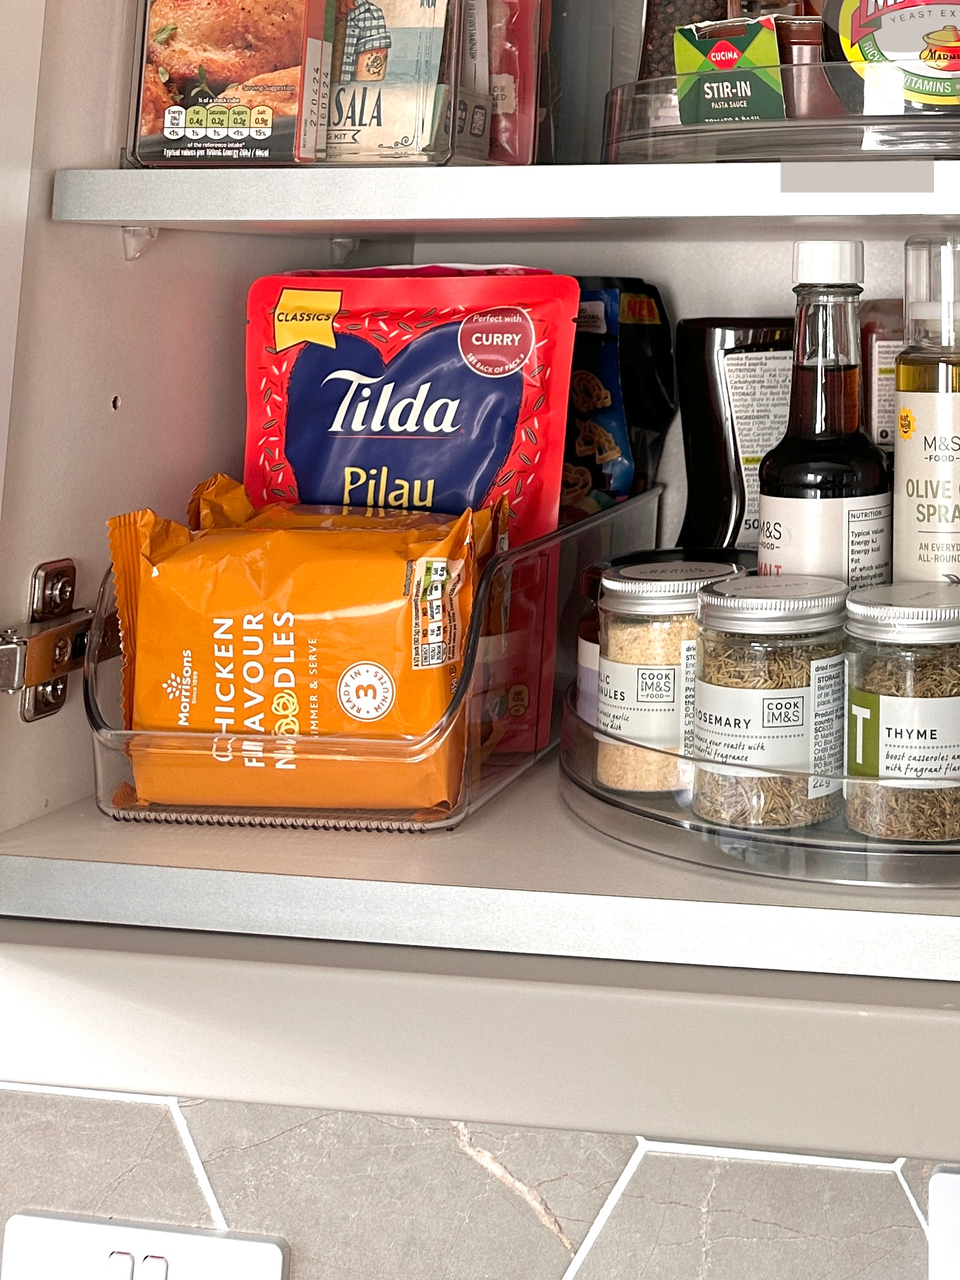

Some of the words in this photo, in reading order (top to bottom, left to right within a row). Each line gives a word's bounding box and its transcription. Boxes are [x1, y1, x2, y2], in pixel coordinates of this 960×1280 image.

[889, 9, 933, 25] YEAST
[710, 51, 739, 61] CUCINA
[309, 66, 320, 127] 270424
[704, 81, 752, 100] STIR-IN
[711, 101, 729, 109] PASTA
[730, 100, 747, 108] SAUCE
[189, 117, 204, 127] 0.4g
[211, 117, 225, 127] 0.2g
[233, 117, 247, 127] 0.2g
[254, 117, 269, 127] 0.9g
[277, 312, 332, 323] CLASSICS
[473, 314, 502, 323] Perfect
[504, 314, 522, 323] with
[471, 333, 522, 346] CURRY
[466, 352, 477, 368] SEE
[475, 362, 494, 373] BACK
[494, 364, 504, 373] OF
[504, 355, 521, 372] PACK
[321, 369, 463, 434] Tilda
[923, 435, 960, 452] M&S
[343, 466, 434, 507] Pilau
[906, 478, 952, 499] OLIVE
[851, 510, 882, 520] NUTRITION
[851, 548, 870, 556] Energy
[919, 542, 929, 551] AN
[308, 638, 318, 674] SERVE
[349, 669, 362, 680] IN
[641, 672, 671, 681] COOK
[177, 649, 193, 727] Morrisons
[309, 680, 318, 690] &
[355, 683, 377, 700] 3
[644, 681, 671, 693] M&S
[343, 683, 362, 714] READY
[374, 670, 390, 714] MINUTES
[767, 701, 800, 711] COOK
[309, 694, 319, 738] IMMER
[612, 713, 630, 722] garlic
[771, 710, 800, 723] M&S
[851, 703, 871, 764] T
[885, 727, 938, 740] THYME
[723, 741, 745, 751] roasts
[747, 742, 765, 751] with
[713, 751, 749, 763] fragrance
[885, 750, 906, 762] boost
[908, 751, 949, 763] casseroles
[885, 761, 903, 772] with
[904, 762, 943, 778] fragrant
